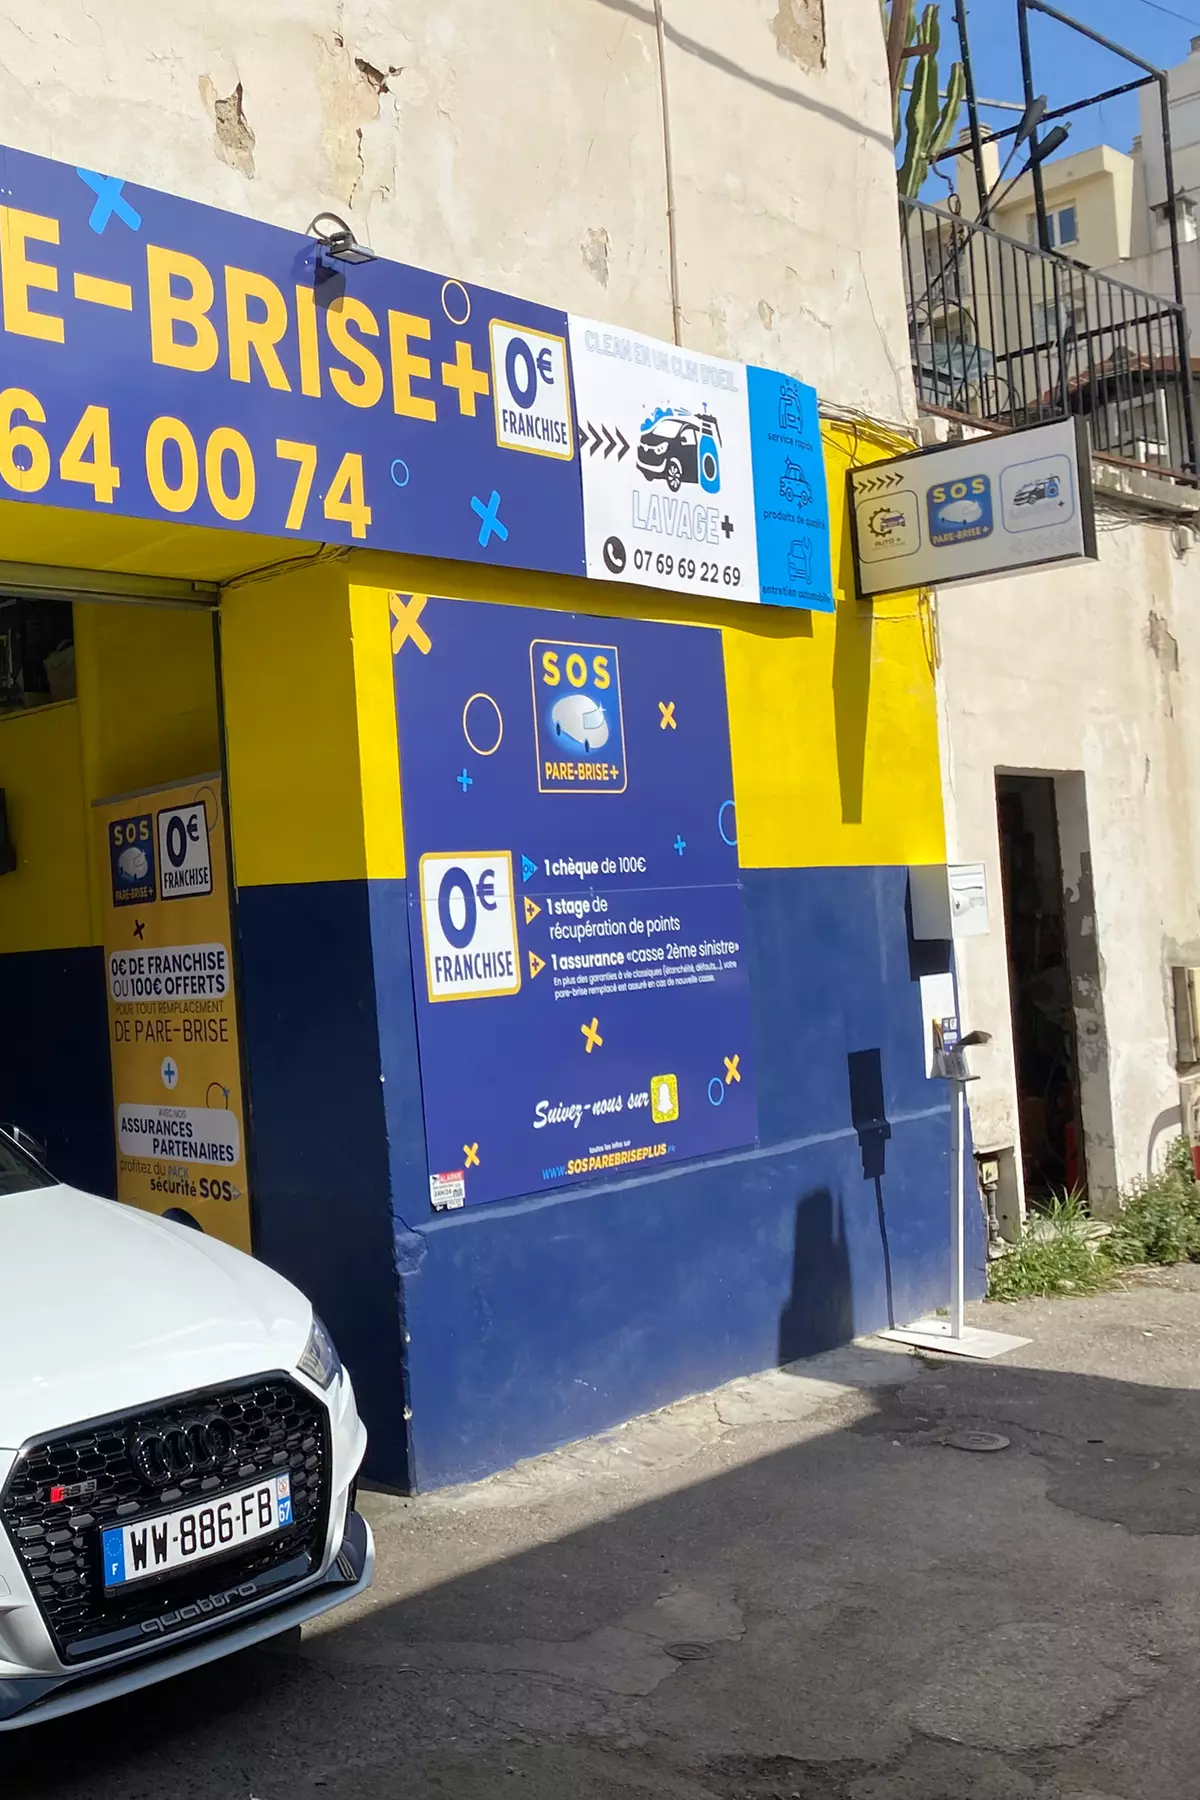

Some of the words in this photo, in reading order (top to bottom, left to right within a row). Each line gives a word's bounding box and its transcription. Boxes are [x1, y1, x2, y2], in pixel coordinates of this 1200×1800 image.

[505, 337, 555, 410] 0€
[501, 408, 568, 446] FRANCHISE
[767, 432, 794, 446] service
[145, 416, 256, 521] 00
[274, 439, 372, 539] 74
[933, 478, 986, 503] SOS
[763, 510, 795, 523] produits
[796, 514, 805, 525] de
[634, 549, 653, 571] 07
[656, 553, 674, 575] 69
[678, 557, 696, 579] 69
[700, 561, 719, 583] 22
[723, 565, 741, 586] 69
[761, 584, 797, 597] entretien
[542, 651, 611, 690] SOS
[113, 820, 150, 846] SOS
[166, 814, 199, 868] 0€
[164, 866, 209, 890] FRANCHISE
[544, 859, 550, 876] 1
[551, 857, 599, 880] chèque
[601, 857, 617, 873] de
[618, 856, 647, 873] 100€
[438, 866, 497, 949] 0€
[546, 898, 553, 915] 1
[554, 897, 591, 919] stage
[592, 896, 608, 913] de
[549, 918, 627, 944] récupération
[629, 916, 644, 933] de
[646, 915, 681, 937] points
[112, 958, 127, 976] 0€
[129, 957, 144, 975] DE
[148, 951, 225, 974] FRANCHISE
[434, 950, 513, 983] FRANCHISE
[551, 954, 558, 970] 1
[559, 951, 625, 970] assurance
[666, 943, 697, 959] 2ème
[113, 980, 128, 997] OU
[131, 977, 162, 996] 100€
[164, 974, 225, 994] OFFERTS
[553, 977, 562, 987] En
[562, 975, 576, 987] plus
[577, 974, 589, 984] des
[589, 970, 618, 985] garanties
[623, 969, 632, 979] vie
[632, 966, 663, 981] classiques
[554, 986, 588, 1001] pare-brise
[588, 983, 618, 996] remplacé
[618, 983, 628, 992] est
[627, 979, 647, 991] assuré
[647, 980, 656, 988] en
[656, 979, 667, 988] cas
[667, 977, 675, 986] de
[675, 974, 699, 985] nouvelle
[115, 1003, 133, 1015] POUR
[135, 1002, 156, 1015] TOUT
[158, 1000, 224, 1014] REMPLACEMENT
[115, 1020, 131, 1042] DE
[135, 1018, 229, 1042] PARE-BRISE
[158, 1108, 173, 1118] AVEC
[174, 1109, 187, 1119] NOS
[533, 1094, 623, 1129] Suivez-nous
[627, 1092, 650, 1110] sur
[121, 1117, 193, 1138] ASSURANCES
[152, 1138, 234, 1162] PARTENAIRES
[120, 1159, 152, 1174] profitez
[153, 1164, 166, 1176] du
[167, 1166, 189, 1178] PACK
[150, 1176, 197, 1197] sécurité
[199, 1177, 232, 1202] SOS
[278, 1500, 291, 1522] 67
[111, 1562, 119, 1576] F
[140, 1582, 257, 1633] quattro
